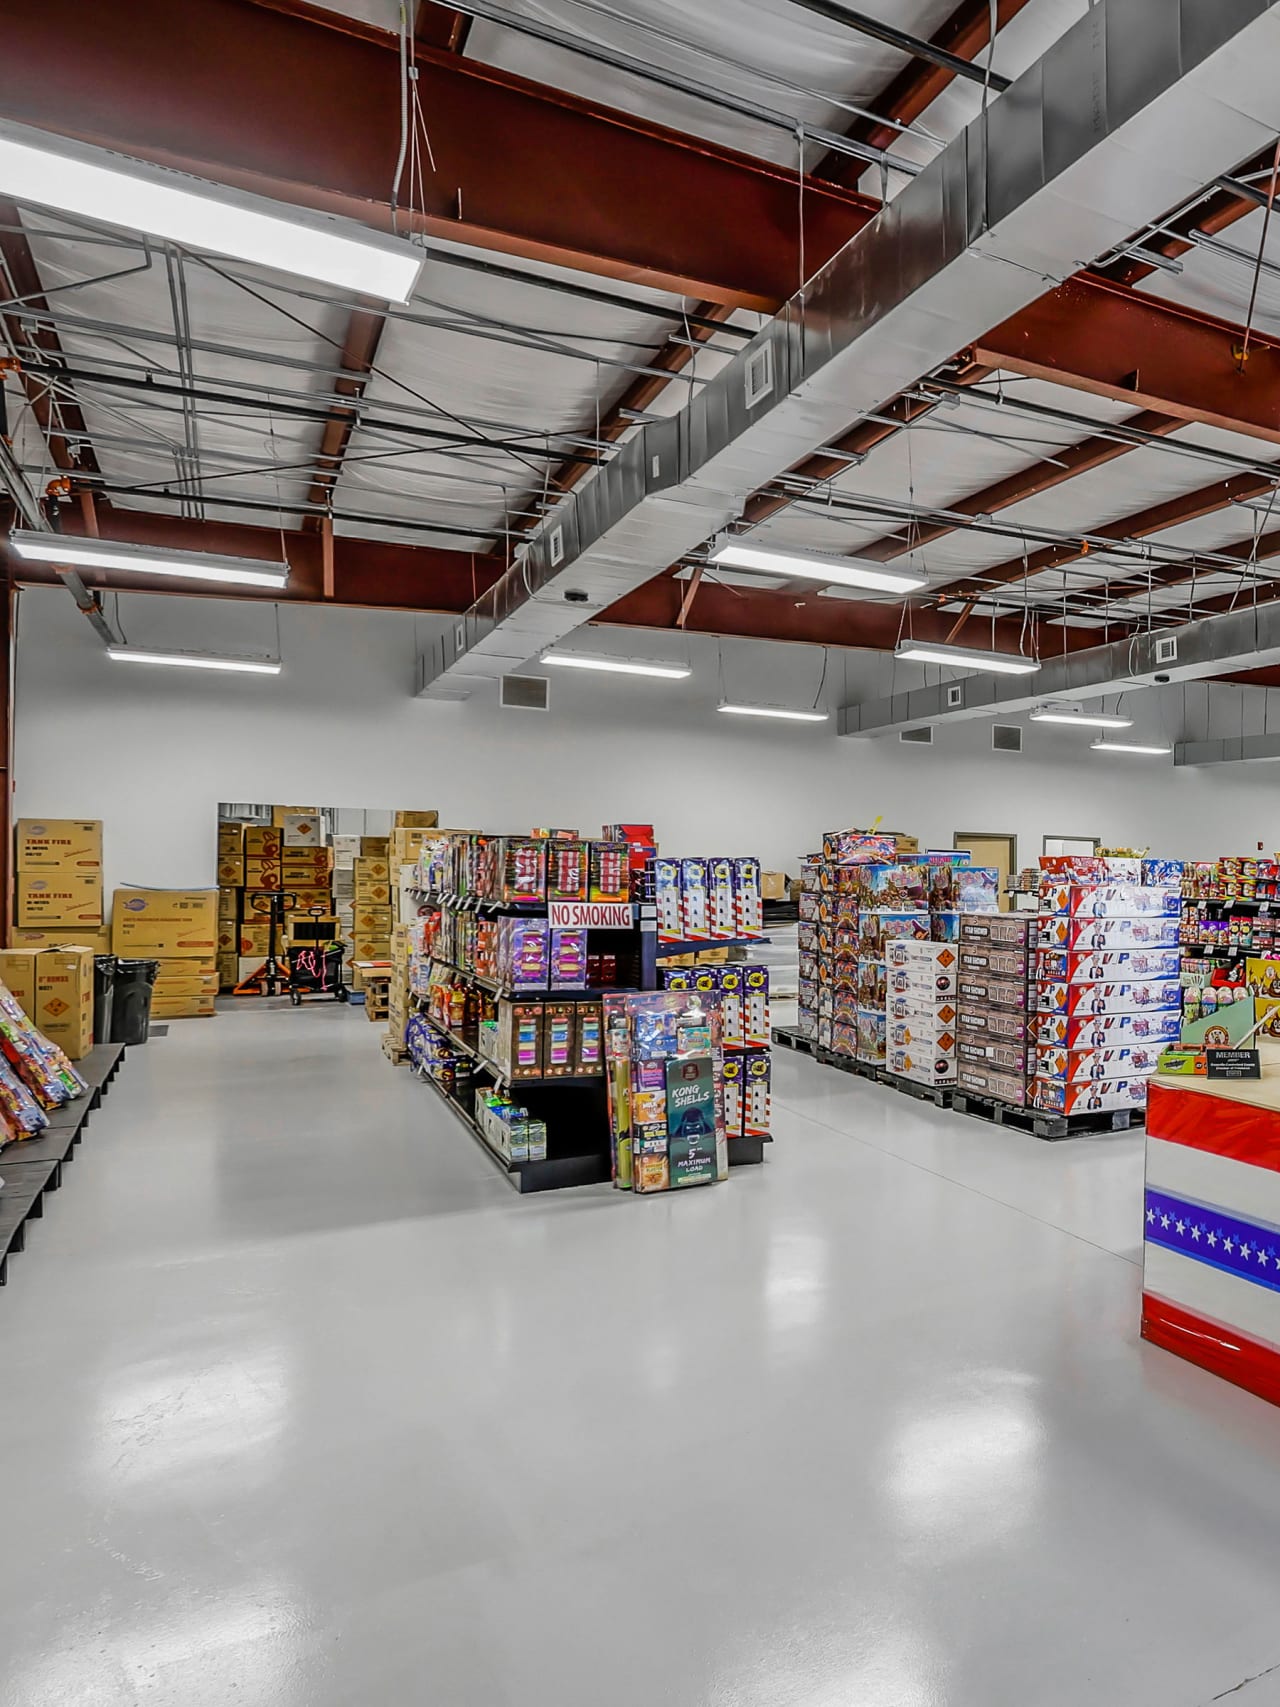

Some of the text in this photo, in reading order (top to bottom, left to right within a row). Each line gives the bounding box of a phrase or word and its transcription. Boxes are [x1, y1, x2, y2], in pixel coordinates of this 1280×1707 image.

[552, 905, 630, 926] NO SMOKING
[672, 1085, 700, 1098] KONG
[675, 1091, 709, 1108] SHELLS
[678, 1158, 711, 1167] MAXIMUM
